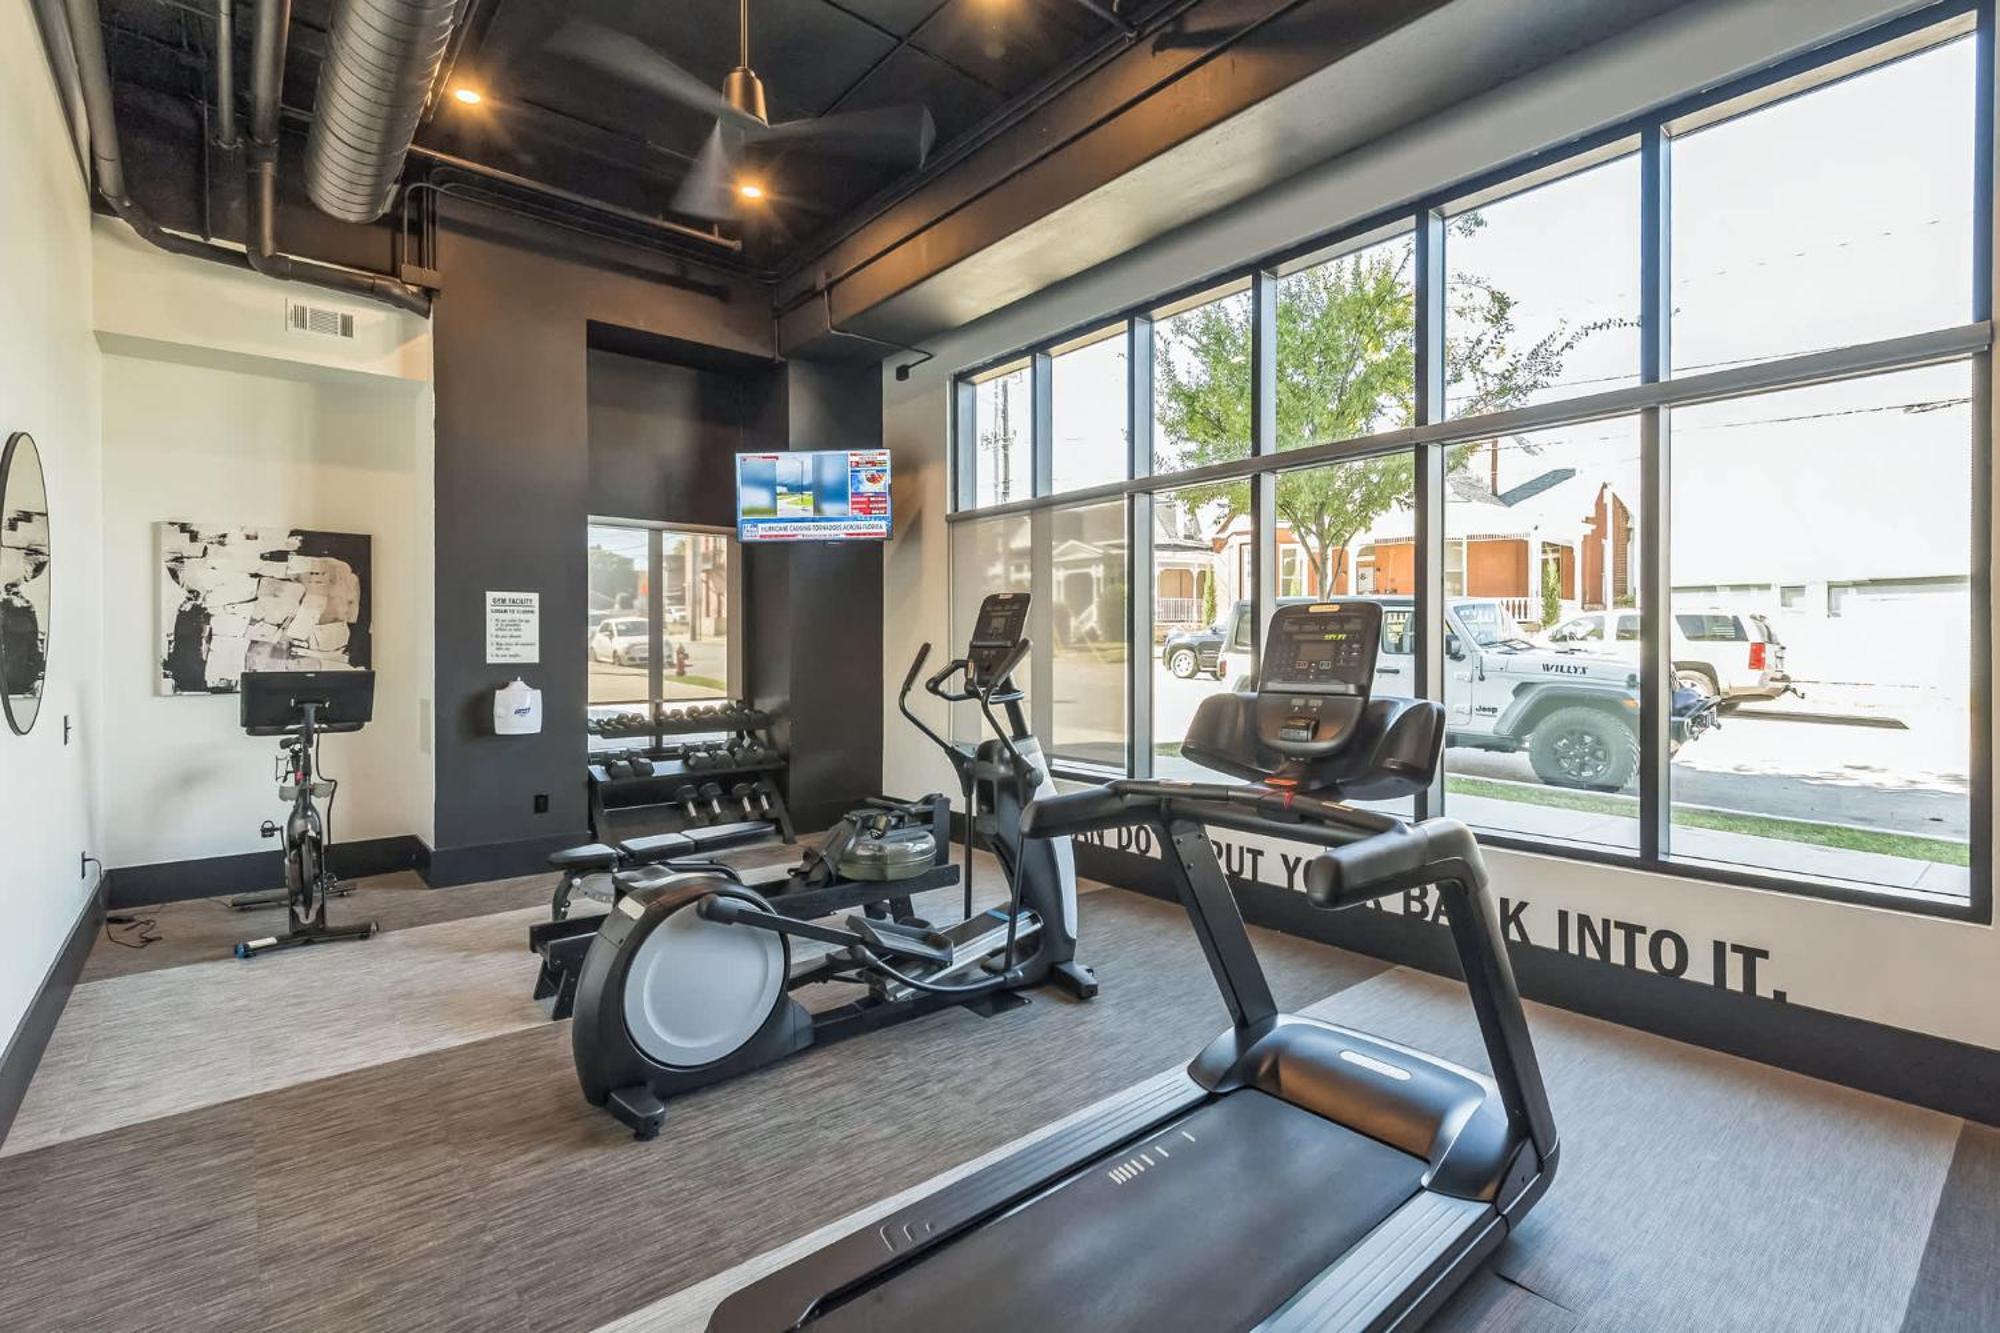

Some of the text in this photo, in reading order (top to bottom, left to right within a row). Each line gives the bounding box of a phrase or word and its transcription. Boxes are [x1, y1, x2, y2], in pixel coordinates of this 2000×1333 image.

[789, 524, 812, 532] CAUSING
[843, 523, 862, 531] ACROSS
[1542, 663, 1588, 675] WILLYS
[1476, 705, 1498, 714] Jeep
[1117, 825, 1151, 855] DO
[1403, 886, 1531, 945] BAK
[1558, 909, 1688, 977] INTO
[1713, 940, 1787, 1003] IT.
